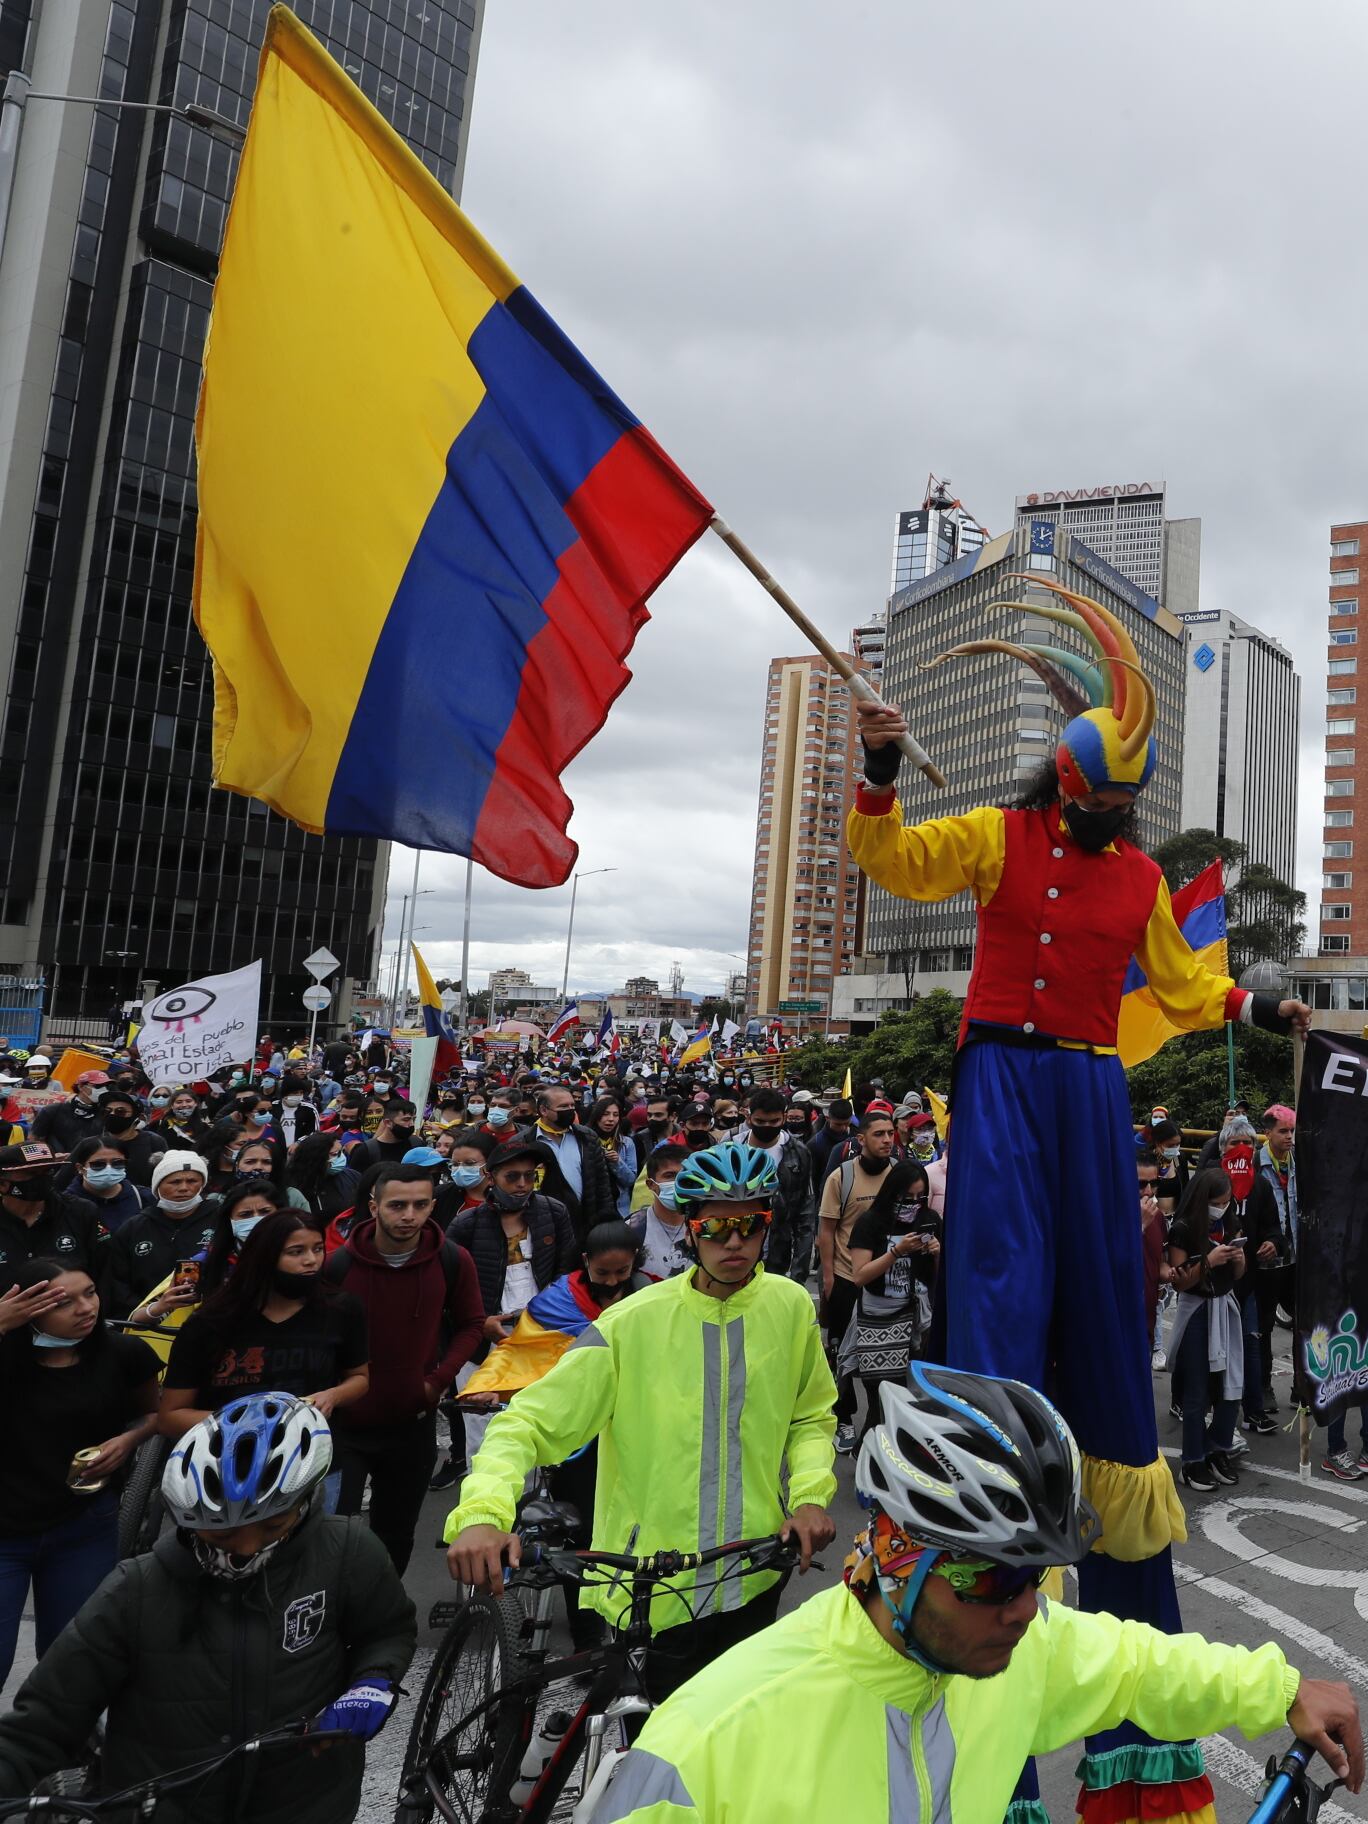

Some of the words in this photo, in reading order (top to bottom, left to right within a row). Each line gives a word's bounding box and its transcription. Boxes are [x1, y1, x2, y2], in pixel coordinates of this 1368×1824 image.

[1043, 482, 1153, 503] DAVIVIENDA
[1085, 557, 1138, 606] Corficolombiana
[1184, 612, 1219, 621] Occidente
[165, 1033, 186, 1045] del
[202, 1019, 244, 1044] pueblo
[923, 1437, 965, 1482] ARMOR
